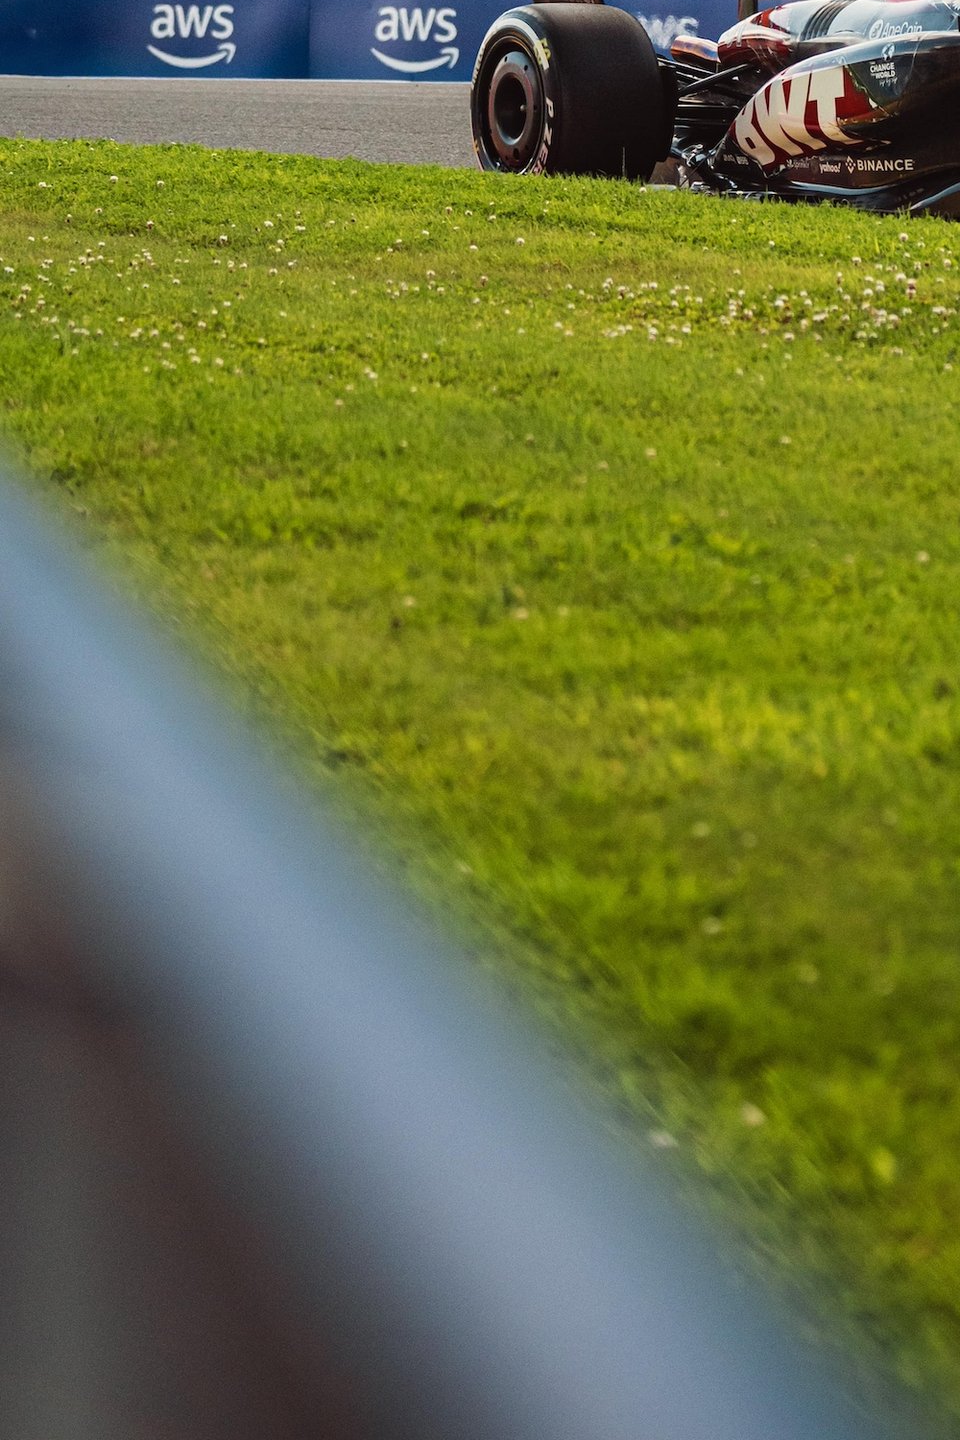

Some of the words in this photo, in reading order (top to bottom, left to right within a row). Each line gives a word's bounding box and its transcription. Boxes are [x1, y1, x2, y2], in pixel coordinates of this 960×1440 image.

[151, 4, 234, 40] aws
[375, 6, 457, 43] aws
[870, 62, 895, 73] CHANGE
[735, 66, 864, 166] BWT
[857, 160, 914, 172] BINANCE
